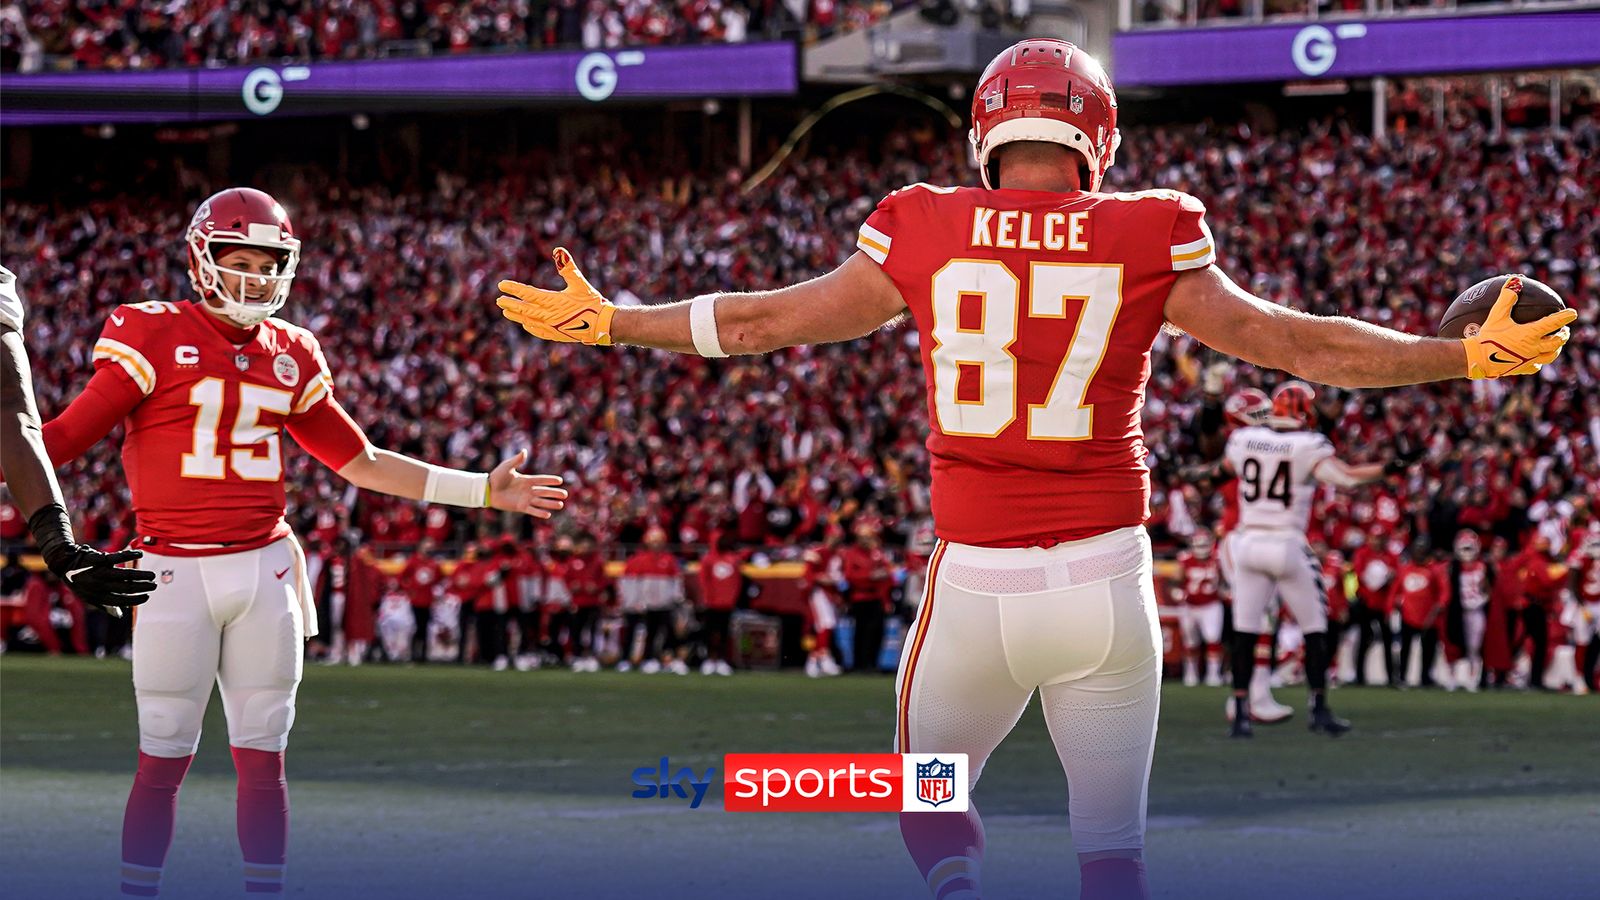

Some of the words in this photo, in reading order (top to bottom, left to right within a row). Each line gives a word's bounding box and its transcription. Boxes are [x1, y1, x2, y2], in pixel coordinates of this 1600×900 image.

[971, 207, 1088, 251] KELCE
[175, 345, 200, 365] C
[931, 258, 1124, 440] 87
[181, 376, 294, 482] 15
[1244, 457, 1291, 509] 94
